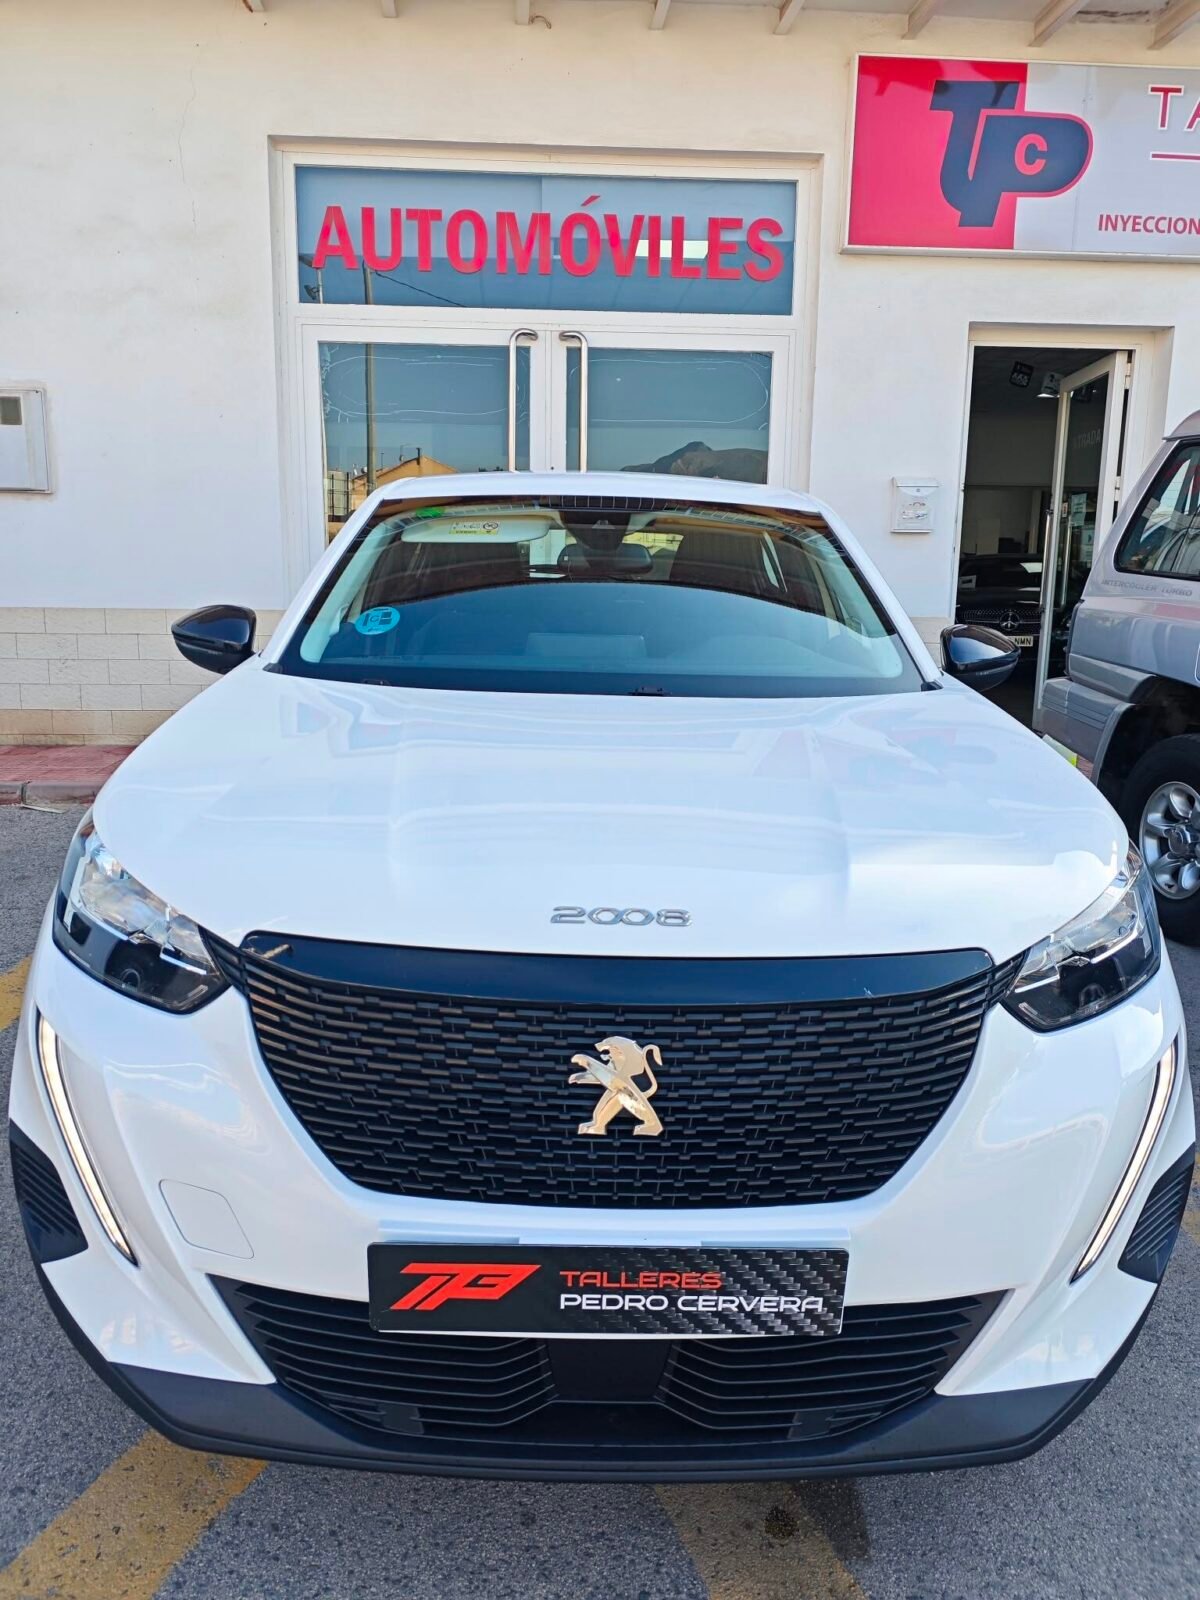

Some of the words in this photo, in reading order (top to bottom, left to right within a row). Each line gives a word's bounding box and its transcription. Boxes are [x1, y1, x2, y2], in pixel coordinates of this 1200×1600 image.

[312, 195, 785, 282] AUTOMÓVILES
[550, 905, 692, 927] 2008
[559, 1271, 723, 1289] TALLERES
[559, 1294, 668, 1311] PEDRO
[676, 1295, 823, 1312] CERVERA
